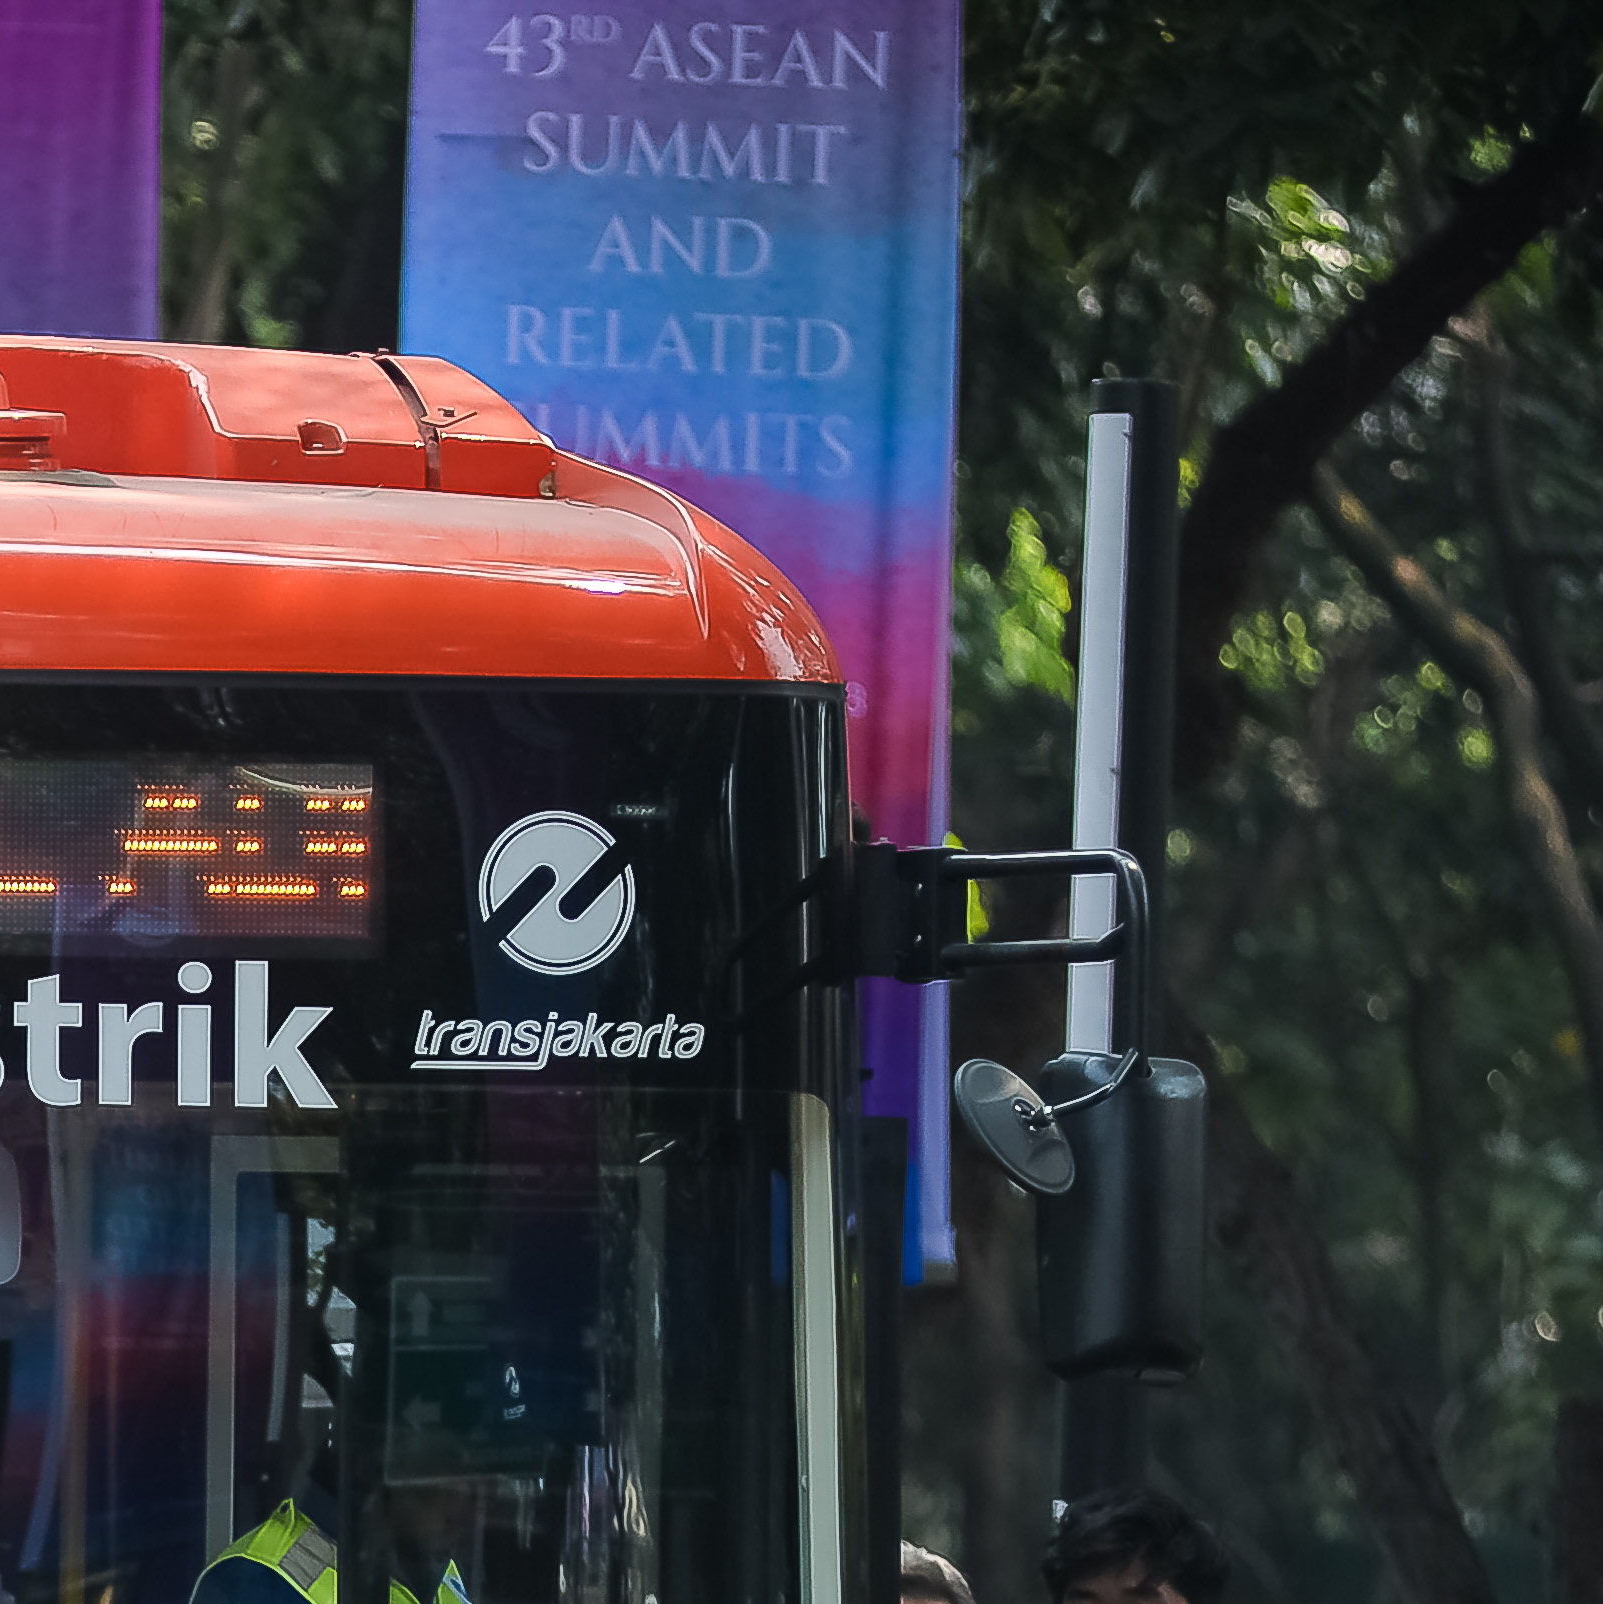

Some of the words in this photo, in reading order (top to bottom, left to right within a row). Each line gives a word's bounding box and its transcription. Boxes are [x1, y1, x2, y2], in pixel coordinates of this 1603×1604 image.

[629, 21, 891, 90] ASEAN
[522, 109, 848, 186] SUMMIT
[587, 214, 774, 278] AND
[504, 304, 855, 379] RELATED
[528, 402, 853, 478] UMMITS
[411, 1009, 705, 1070] transjakarta
